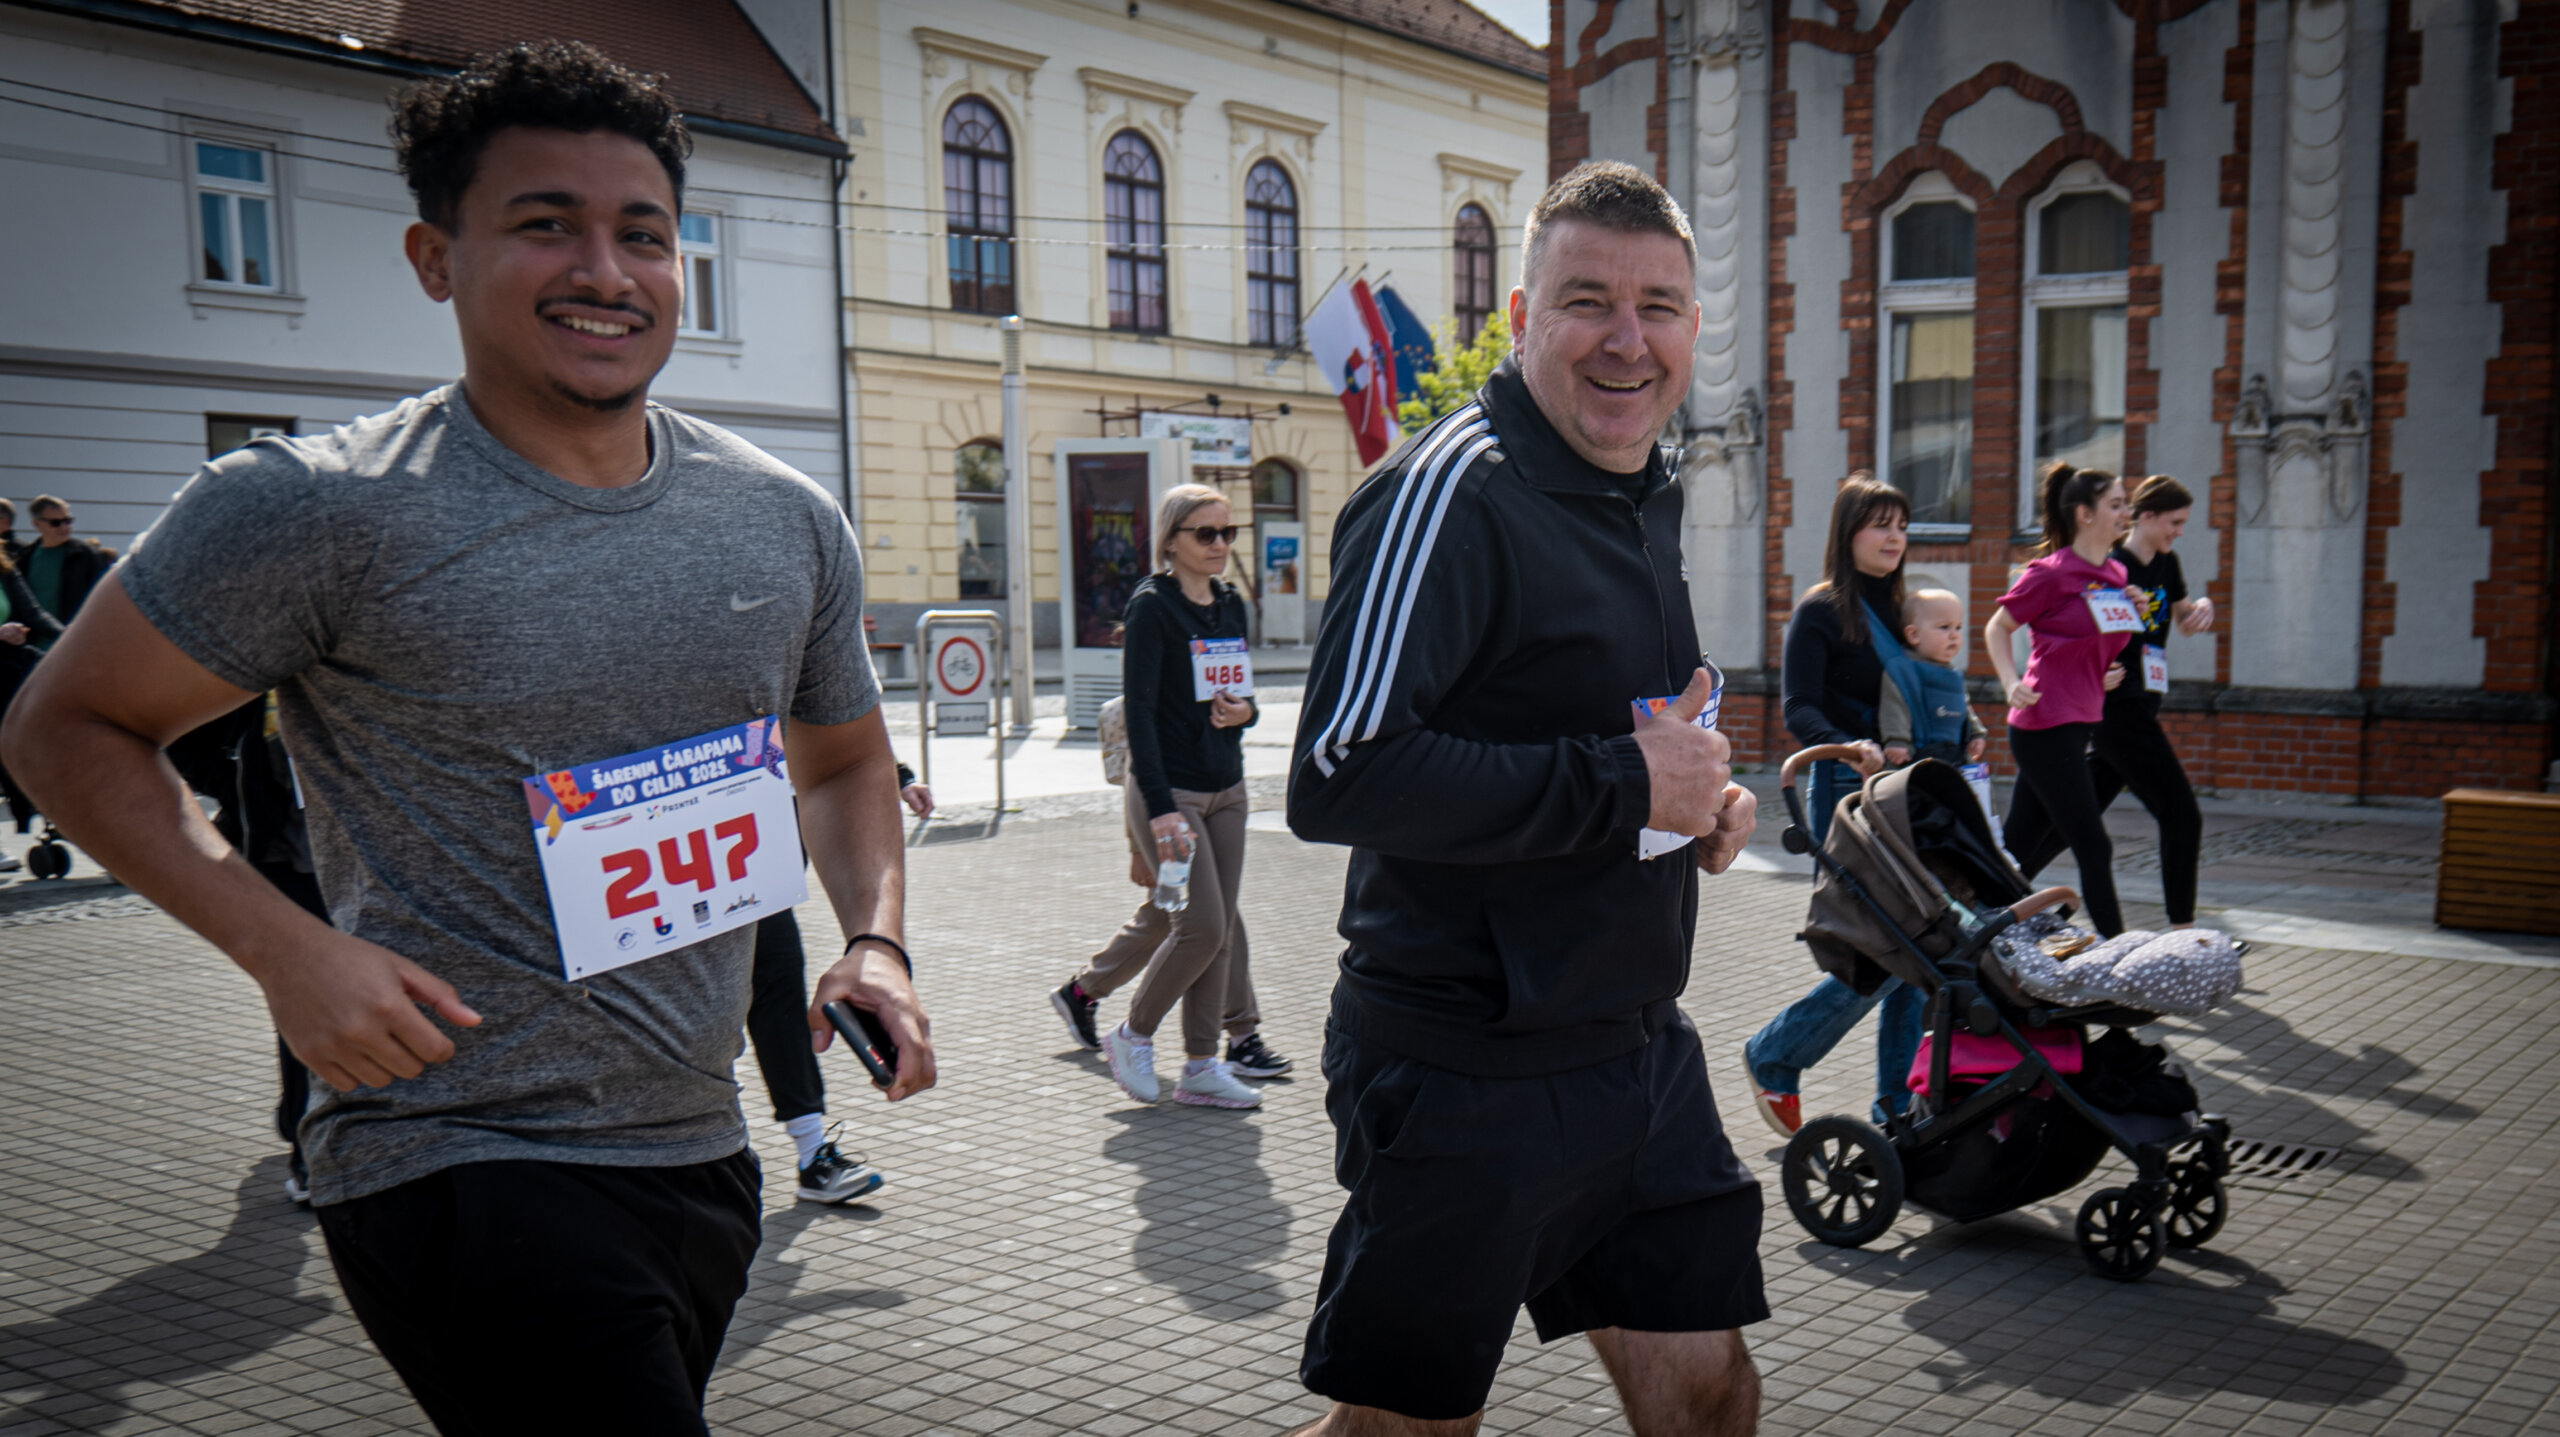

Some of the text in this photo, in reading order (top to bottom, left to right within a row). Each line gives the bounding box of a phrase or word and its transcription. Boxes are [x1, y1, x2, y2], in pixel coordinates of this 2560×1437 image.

[1204, 664, 1244, 686] 486
[591, 734, 744, 790] ŠARENIM ČARAPAMA
[611, 784, 636, 806] DO
[641, 771, 686, 798] CILJA
[689, 758, 731, 784] 2025.
[601, 812, 760, 920] 247
